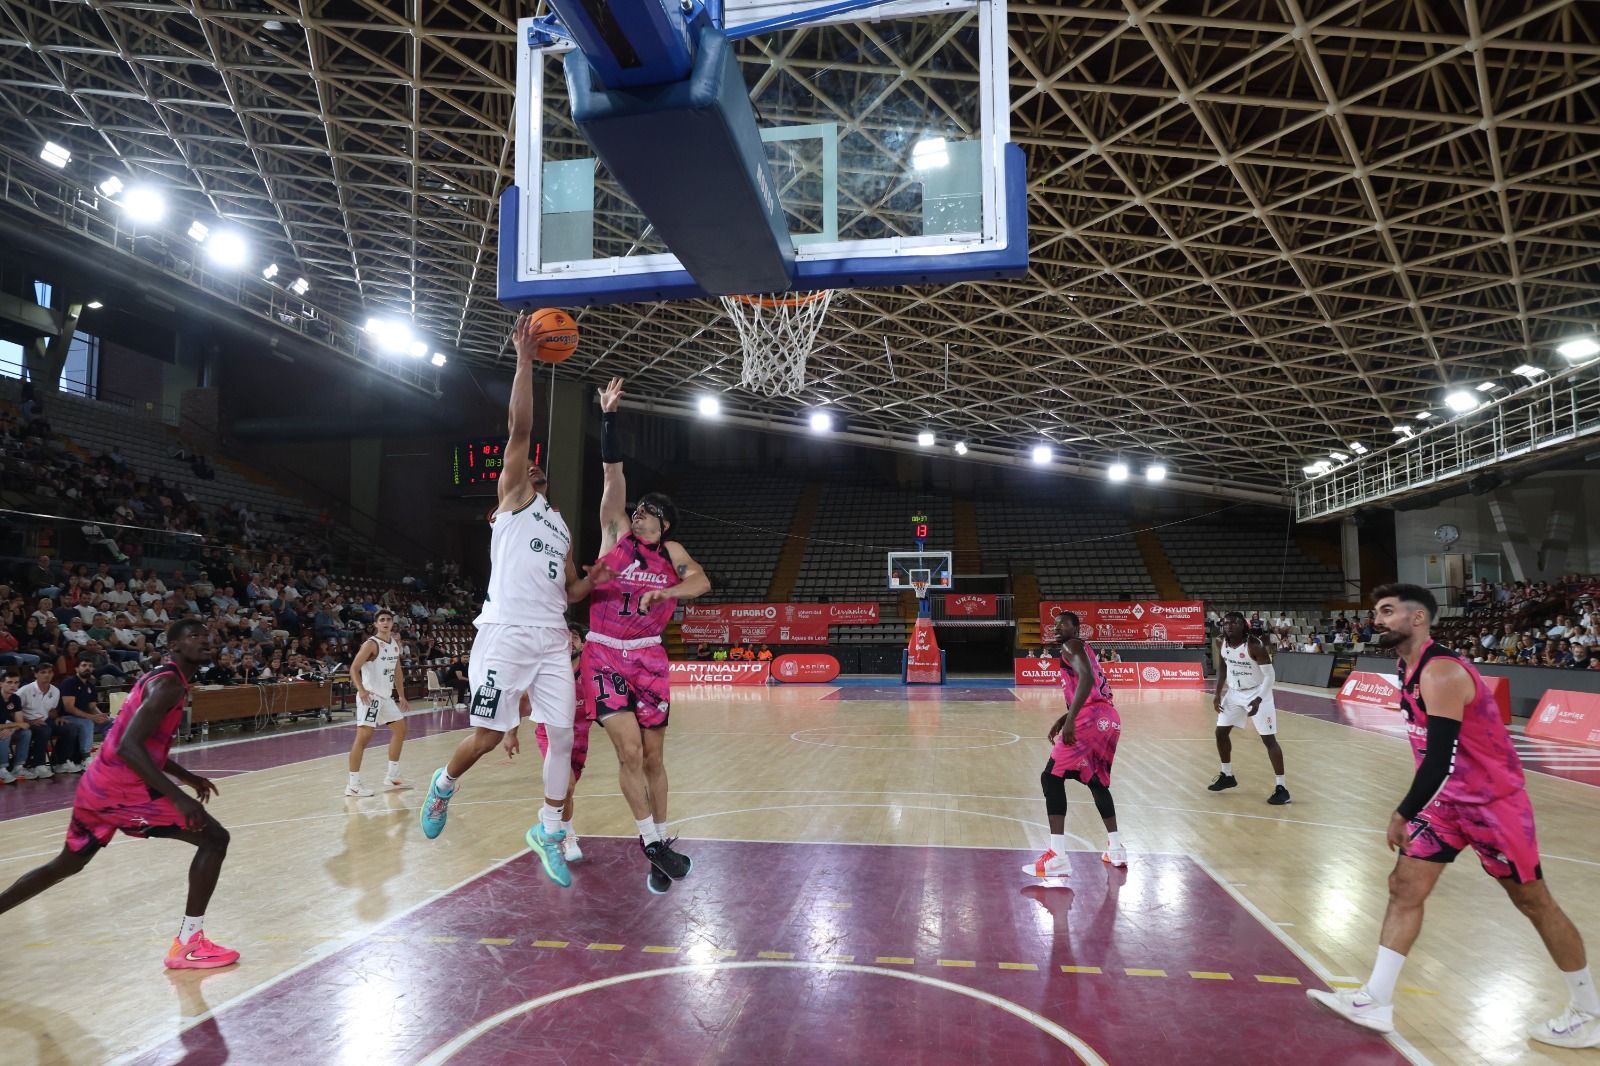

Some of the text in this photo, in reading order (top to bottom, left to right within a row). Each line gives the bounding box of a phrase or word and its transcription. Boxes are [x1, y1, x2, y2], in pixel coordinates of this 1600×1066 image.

[485, 458, 504, 467] 08:3
[917, 524, 927, 537] 13
[548, 560, 558, 580] 5
[668, 664, 762, 672] MARTINAUTO
[1161, 669, 1200, 677] Altar Suites
[485, 668, 497, 687] 5
[690, 674, 733, 682] IVECO
[479, 686, 497, 698] BUN
[474, 705, 493, 717] HAM
